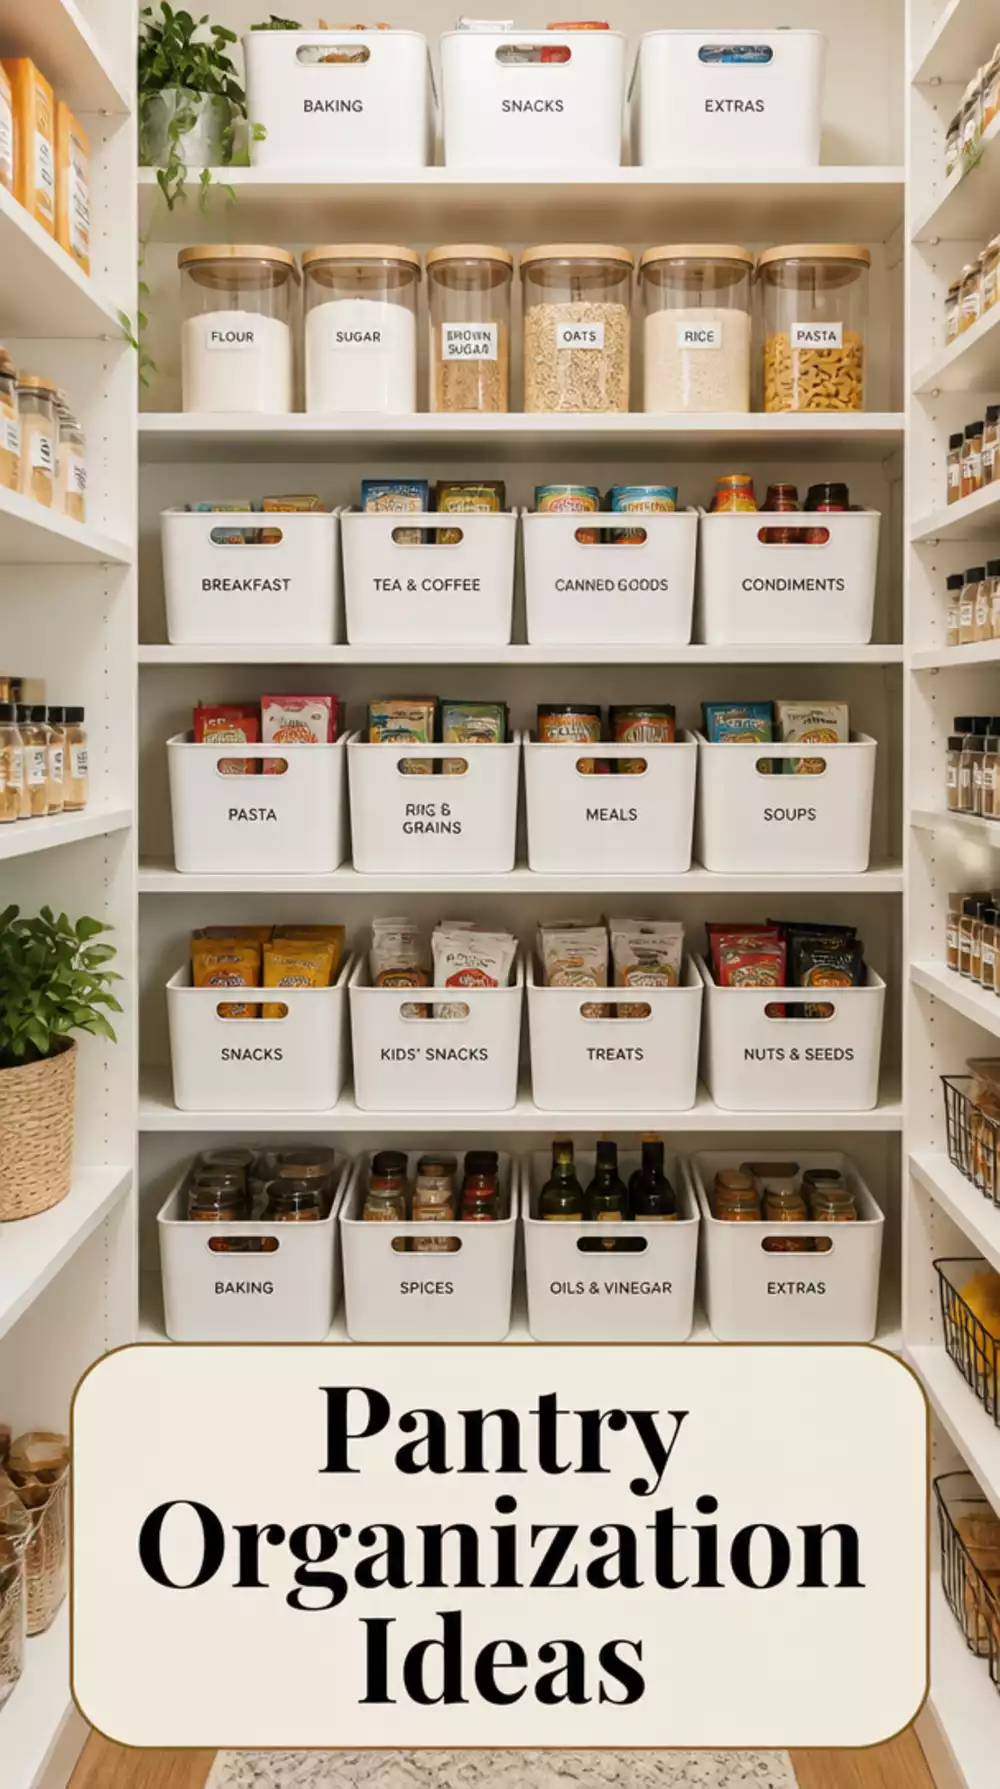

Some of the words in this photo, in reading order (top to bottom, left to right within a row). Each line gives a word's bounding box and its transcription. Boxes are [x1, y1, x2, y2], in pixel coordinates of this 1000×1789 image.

[303, 99, 364, 113] BAKING
[501, 99, 564, 113] SNACKS
[704, 99, 765, 113] EXTRAS
[211, 331, 254, 343] FLOUR
[335, 331, 381, 343] SUGAR
[562, 330, 597, 343] OATS
[684, 330, 714, 343] RICE
[796, 330, 837, 342] PASTA
[201, 578, 291, 592] BREAKFAST
[373, 578, 402, 592] TEA
[406, 578, 417, 592] &
[420, 578, 481, 592] COFFEE
[554, 578, 616, 592] CANNED
[617, 578, 669, 592] GOODS
[741, 577, 845, 592] CONDIMENTS
[228, 807, 277, 822] PASTA
[586, 807, 638, 822] MEALS
[763, 807, 817, 822] SOUPS
[402, 820, 462, 835] GRAINS
[221, 1047, 284, 1062] SNACKS
[425, 1047, 489, 1062] SNACKS
[586, 1047, 644, 1061] TREATS
[744, 1047, 786, 1061] NUTS
[788, 1047, 800, 1061] &
[804, 1047, 855, 1061] SEEDS
[214, 1281, 274, 1295] BAKING
[400, 1281, 454, 1295] SPICES
[549, 1281, 585, 1295] OILS
[588, 1281, 600, 1295] &
[603, 1281, 672, 1295] VINEGAR
[767, 1281, 826, 1295] EXTRAS
